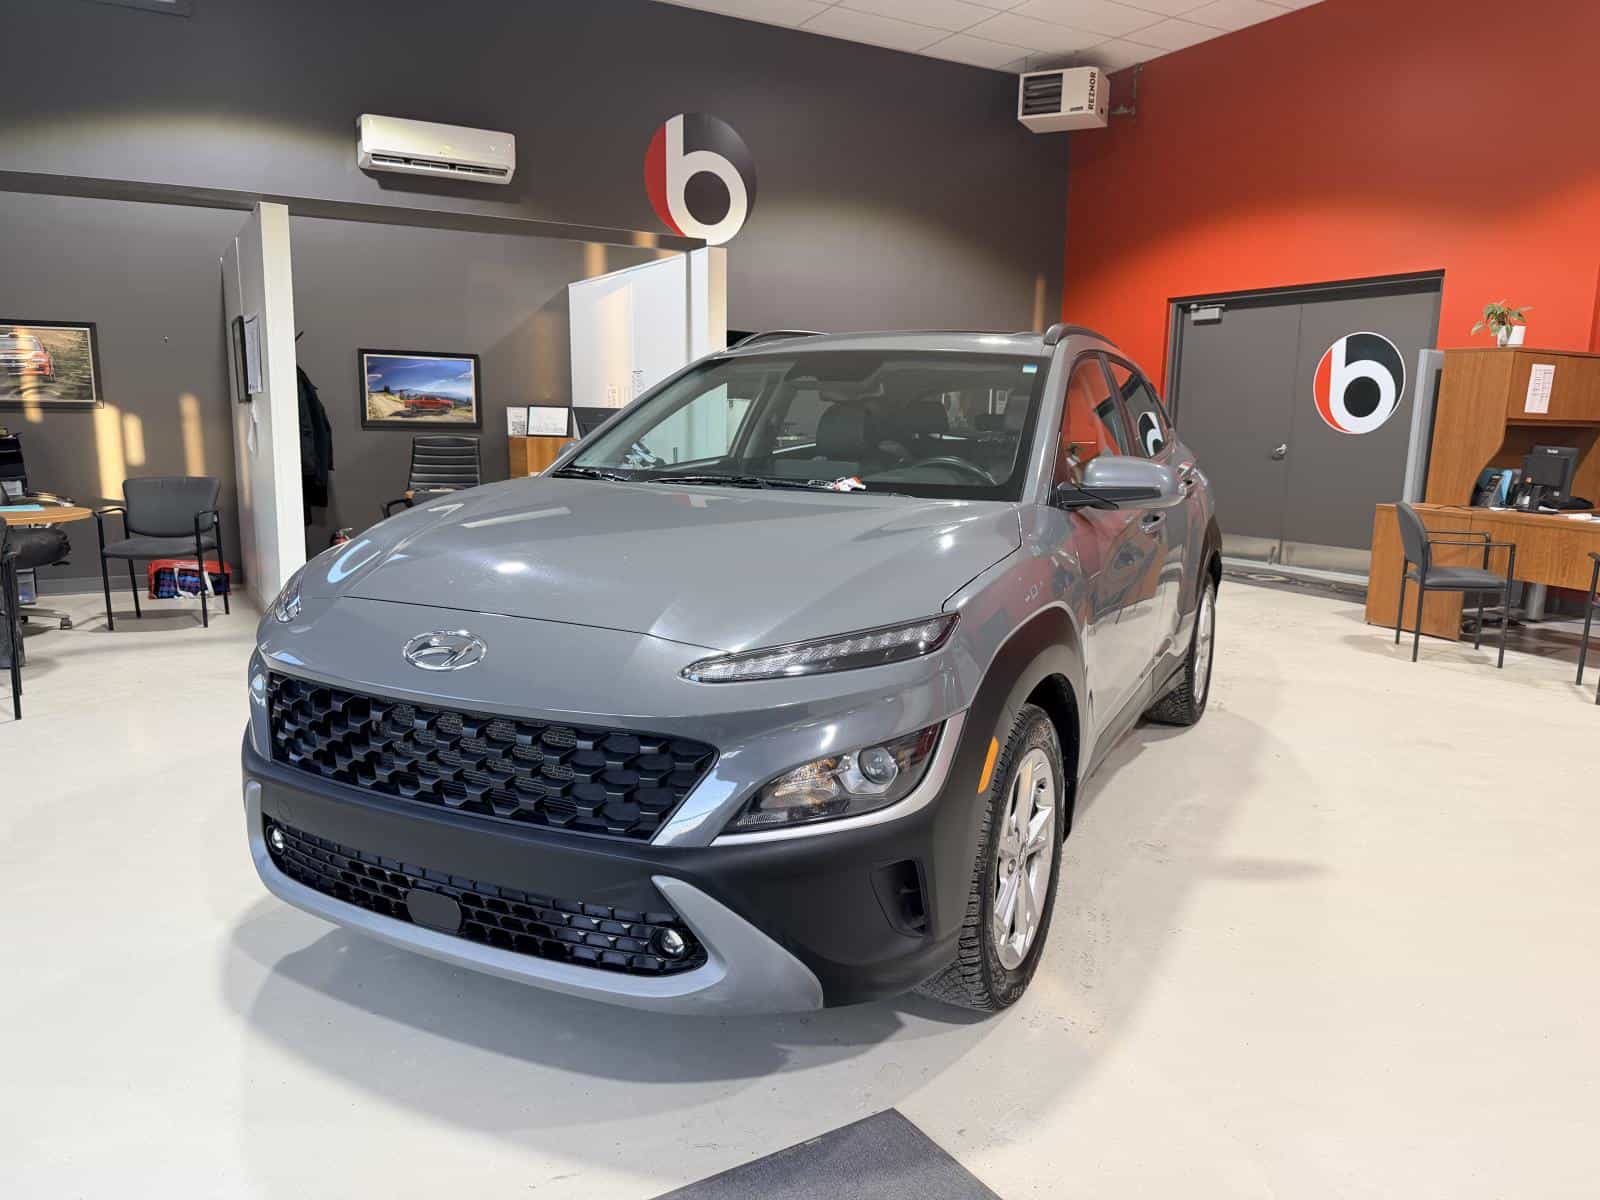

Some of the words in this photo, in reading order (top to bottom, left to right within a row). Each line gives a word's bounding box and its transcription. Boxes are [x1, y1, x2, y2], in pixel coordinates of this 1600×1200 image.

[1088, 71, 1097, 110] REZNOR
[665, 113, 748, 246] b
[1329, 335, 1396, 434] b
